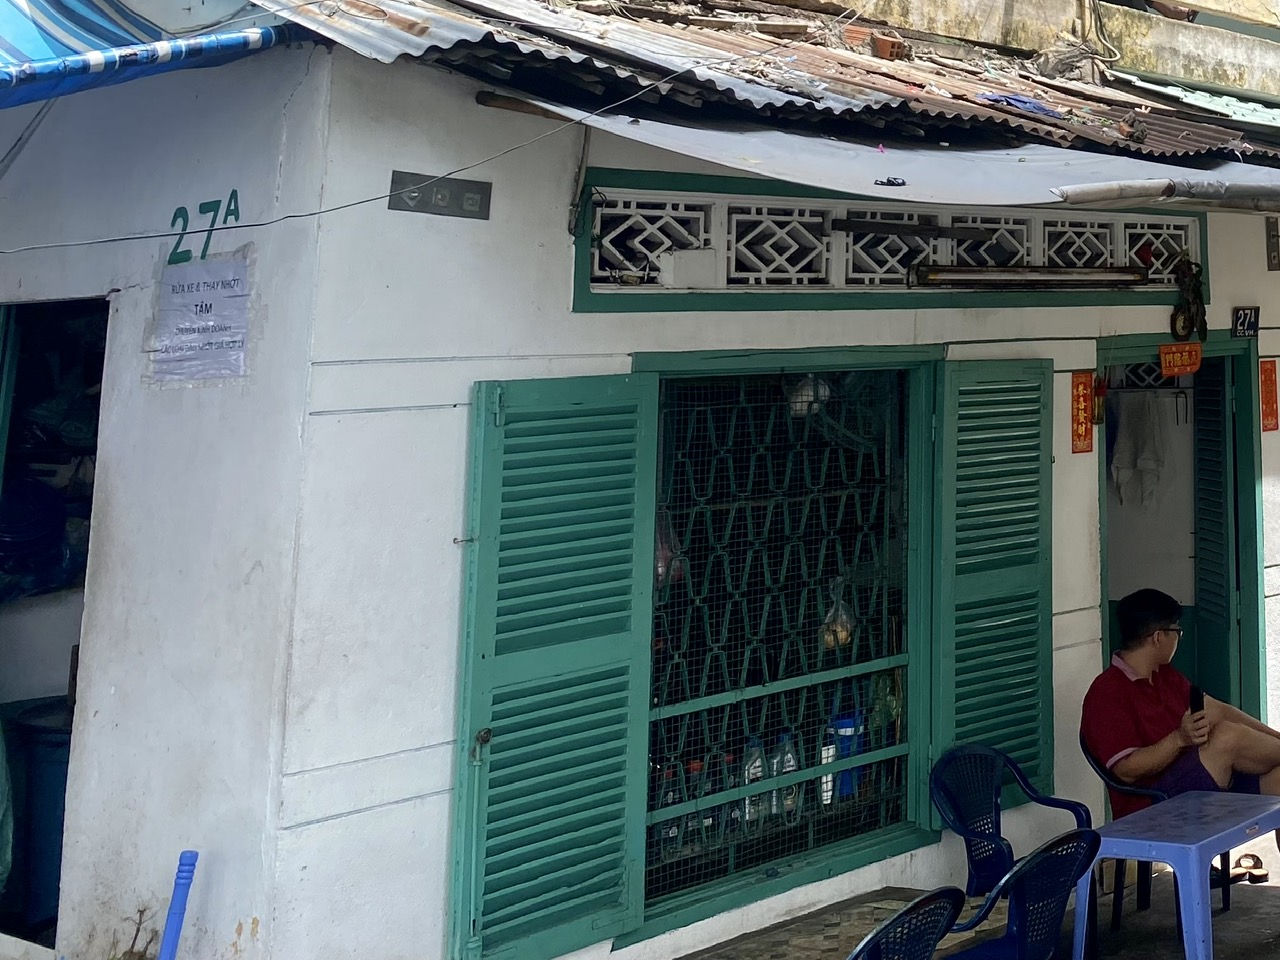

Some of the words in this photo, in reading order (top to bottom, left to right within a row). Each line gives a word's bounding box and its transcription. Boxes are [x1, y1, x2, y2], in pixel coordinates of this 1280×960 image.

[168, 189, 240, 265] 27A
[187, 283, 195, 293] XE
[196, 282, 201, 292] &
[203, 280, 220, 292] THAY
[221, 277, 240, 290] NHỚT
[195, 301, 213, 315] TÂM
[1237, 309, 1255, 330] 27A
